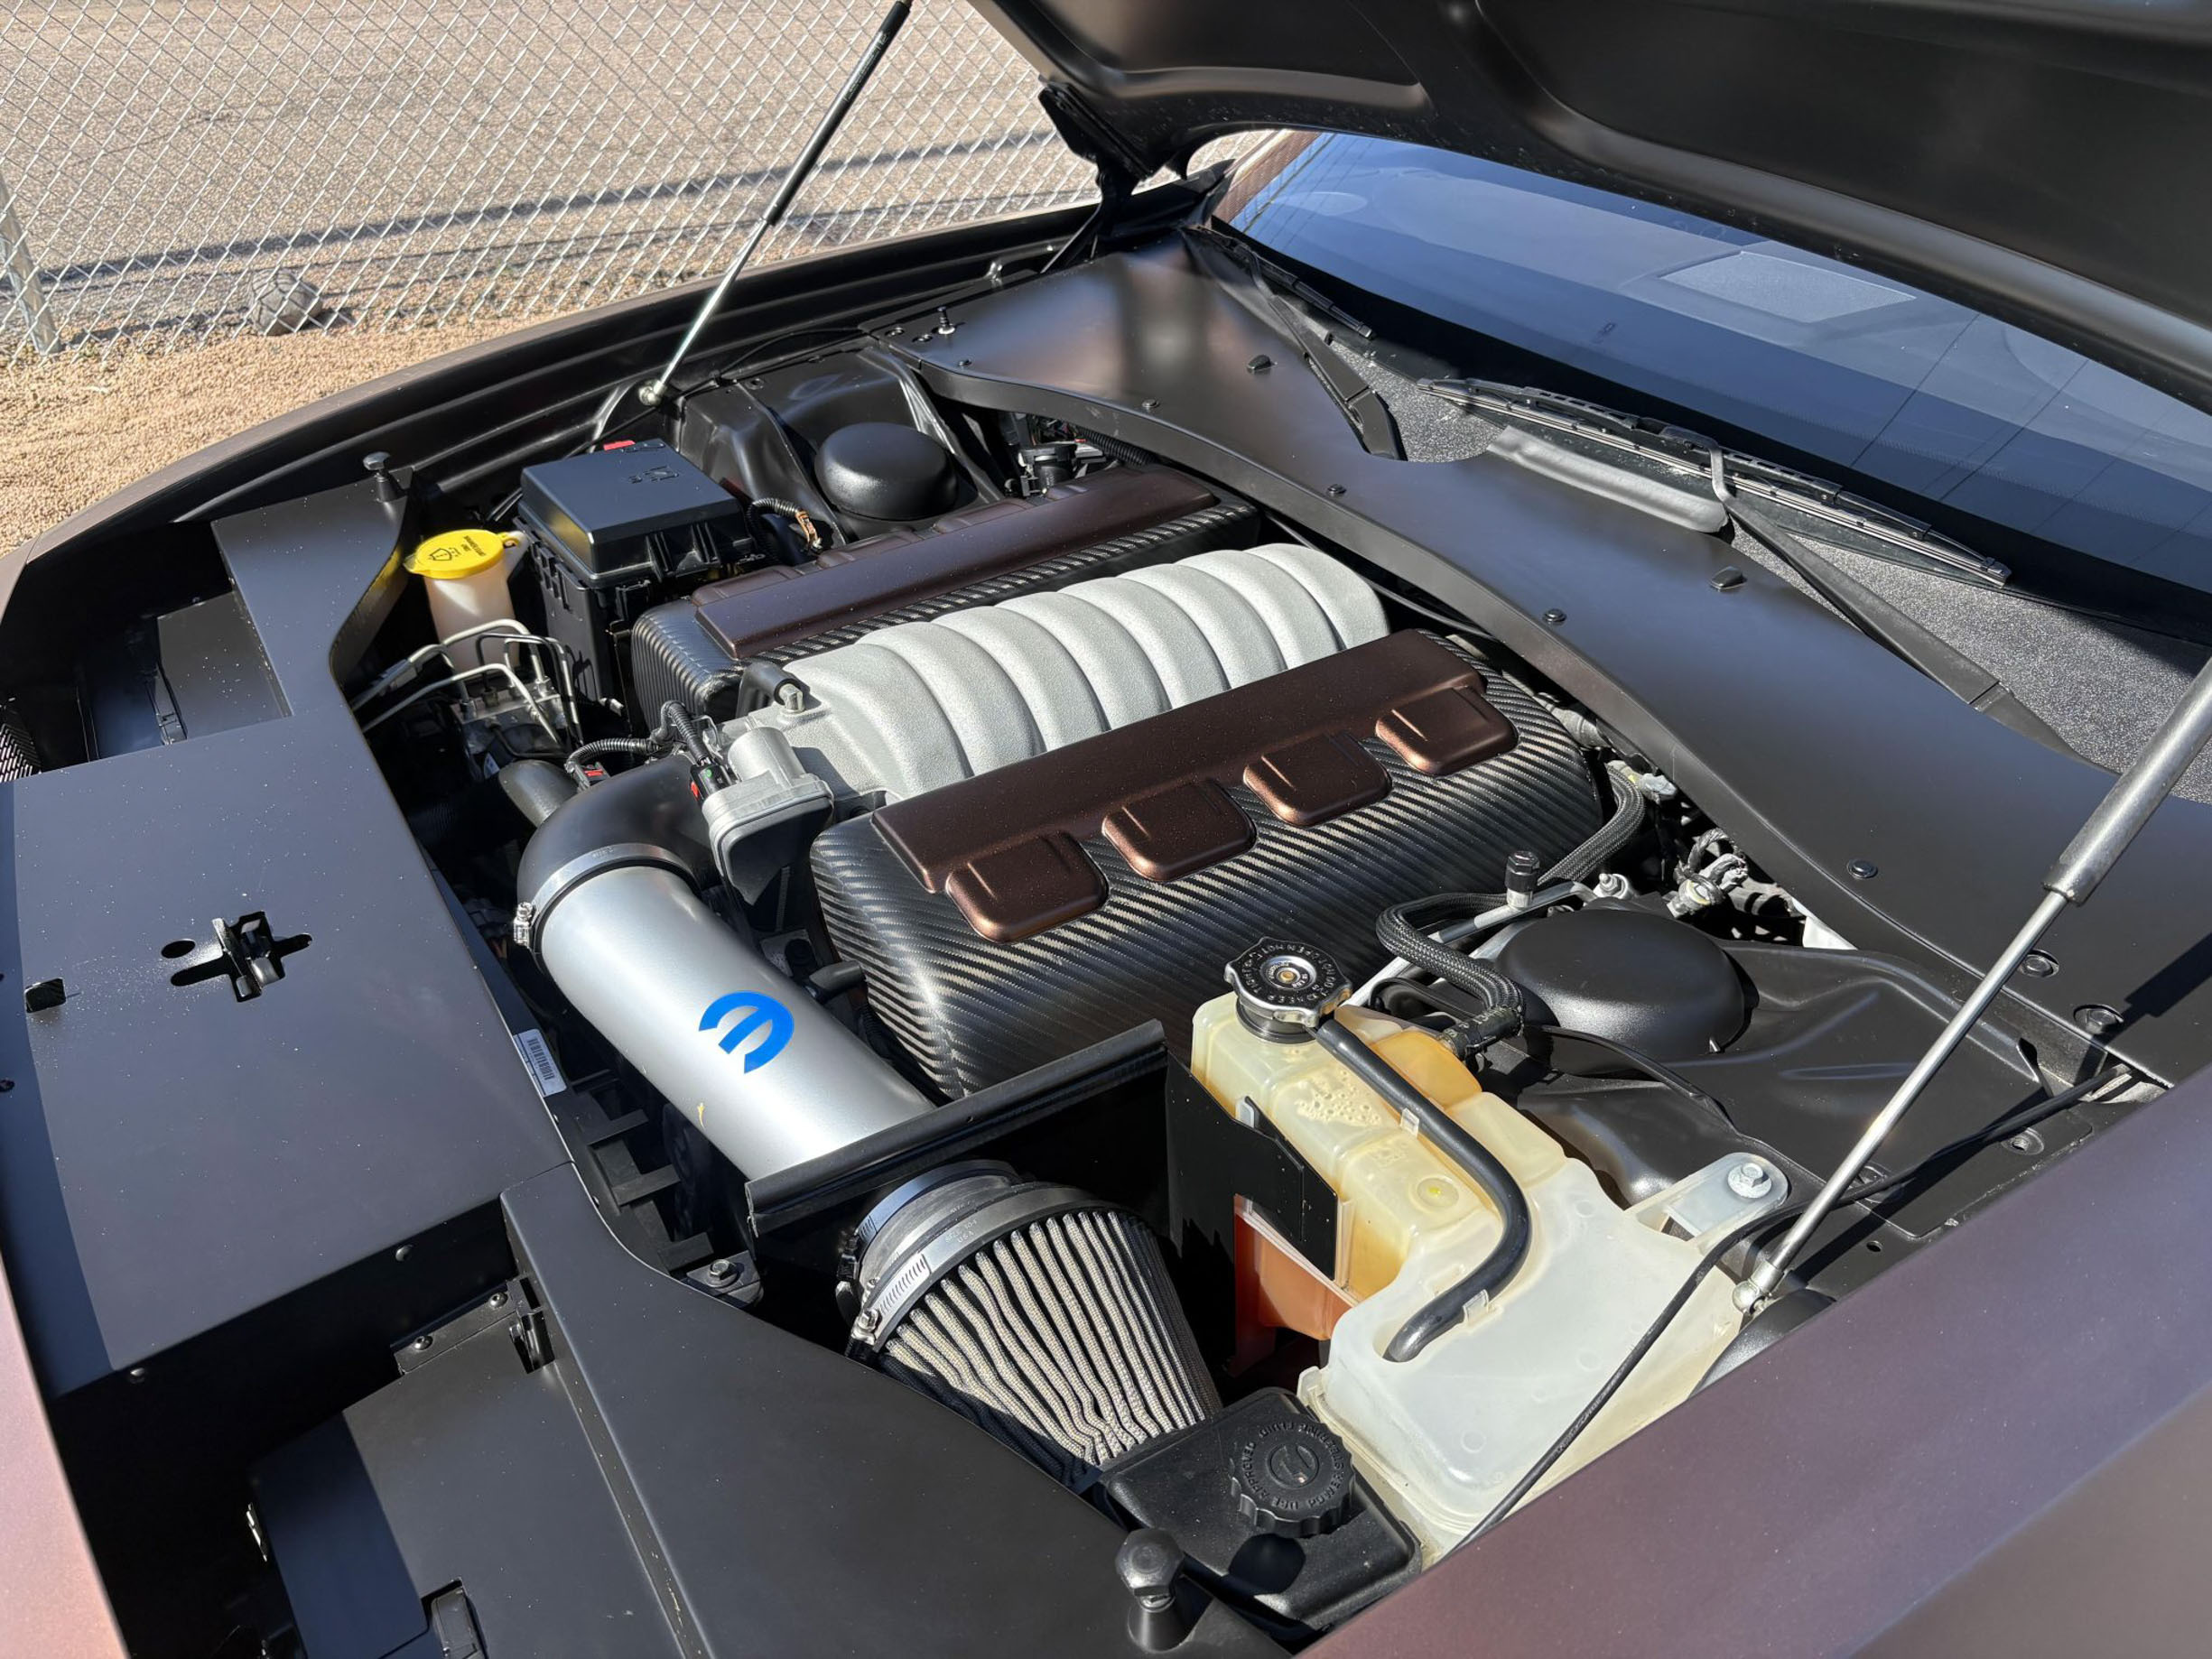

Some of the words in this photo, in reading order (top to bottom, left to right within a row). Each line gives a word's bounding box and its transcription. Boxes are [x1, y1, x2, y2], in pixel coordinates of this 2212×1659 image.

[1259, 1422, 1294, 1438] FLUID
[1298, 1423, 1344, 1470] STEERING
[1241, 1441, 1269, 1499] APPROVED
[1307, 1471, 1344, 1508] POWER
